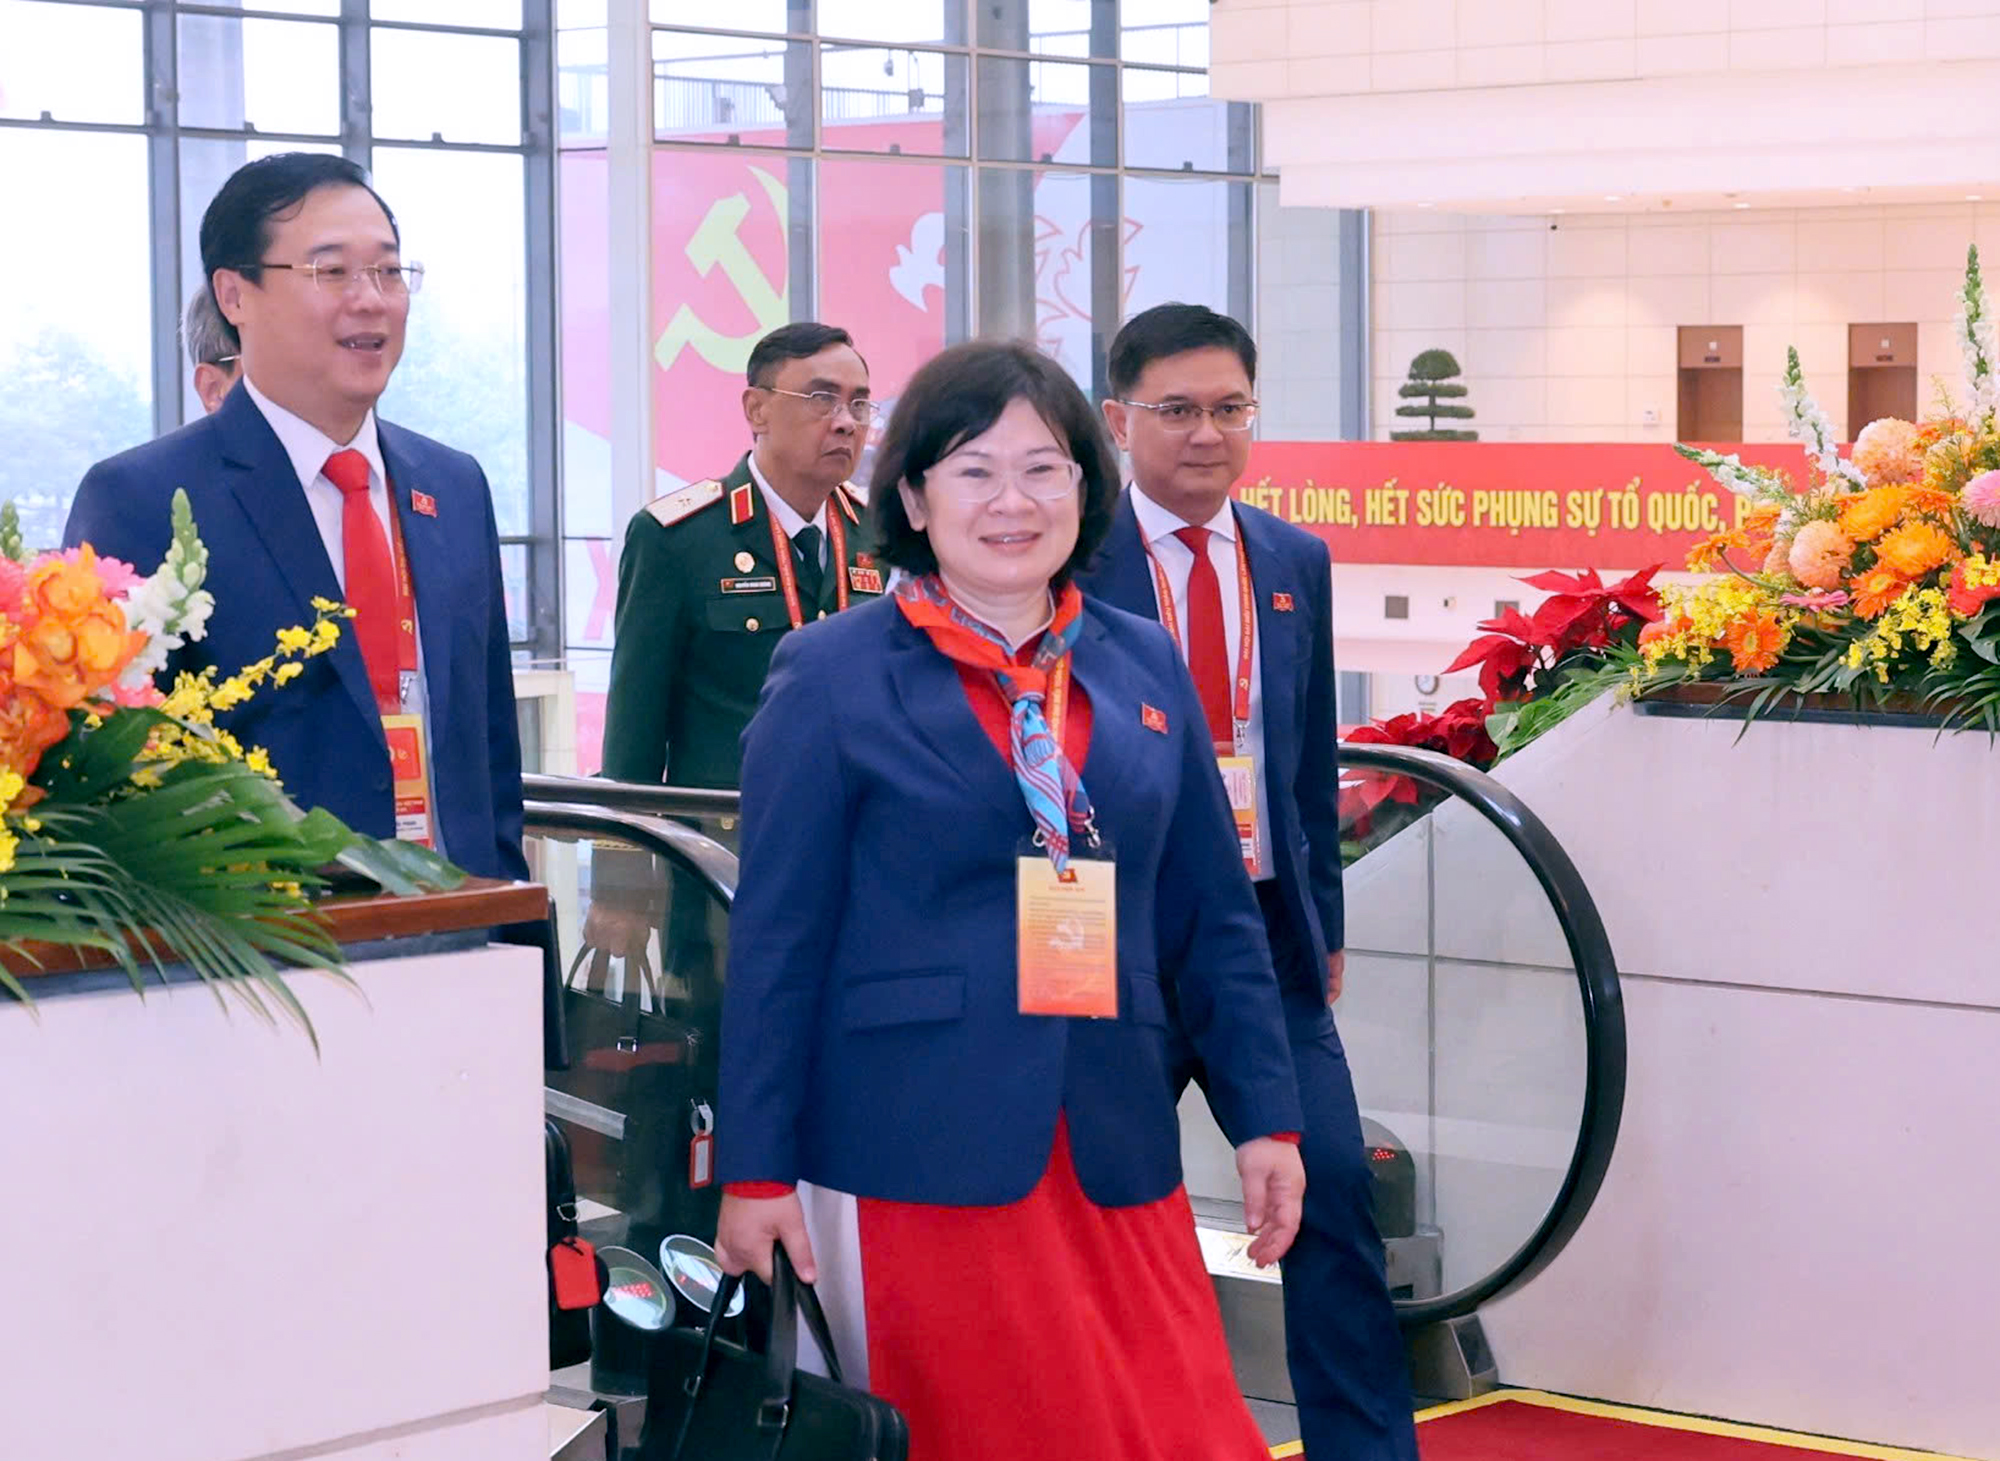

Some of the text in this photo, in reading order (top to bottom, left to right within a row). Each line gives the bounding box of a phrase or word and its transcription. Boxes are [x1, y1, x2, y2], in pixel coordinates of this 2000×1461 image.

[1289, 478, 1359, 529] LÒNG,
[1365, 477, 1409, 525] HẾT
[1416, 481, 1466, 527] SỨC
[1473, 489, 1558, 536] PHỤNG
[1566, 488, 1604, 536] SỰ
[1607, 476, 1641, 529] TỔ
[1648, 479, 1727, 535] QUỐC,
